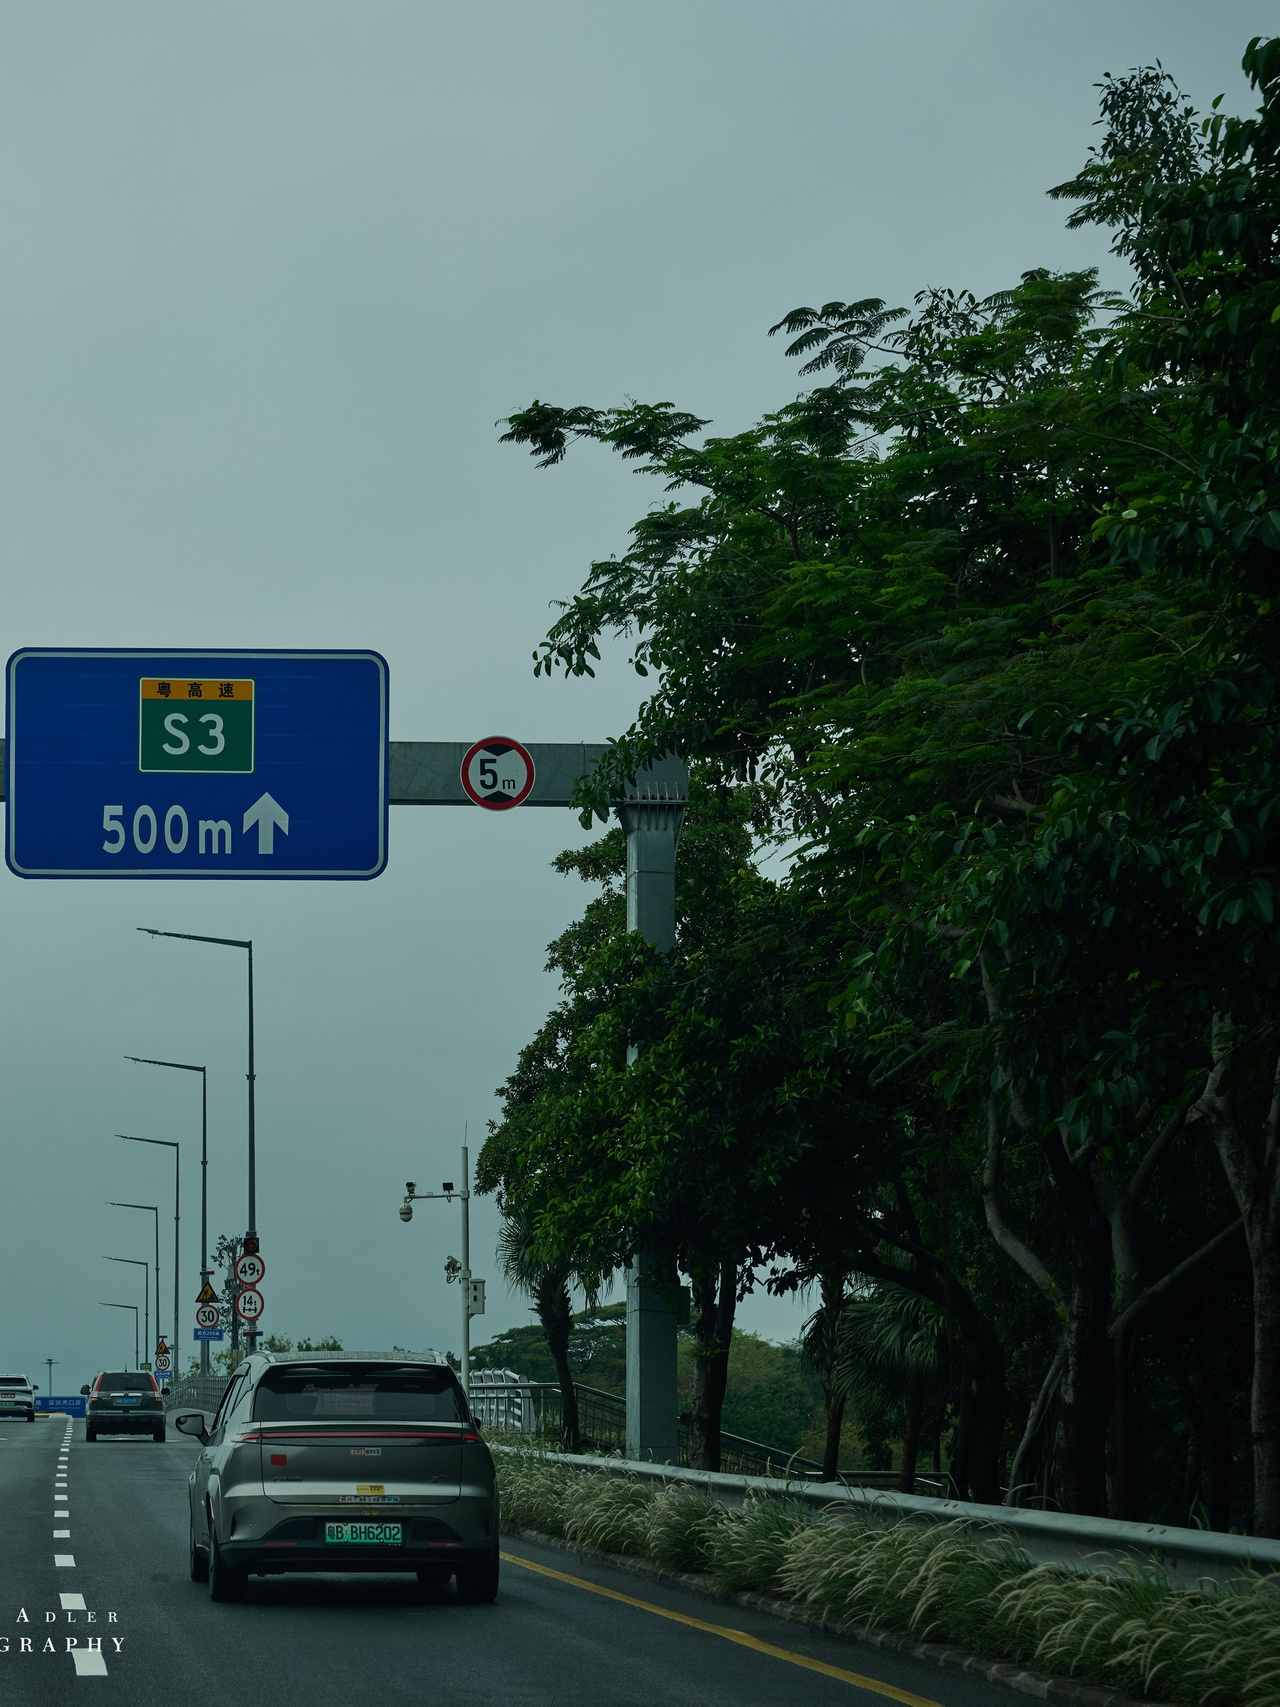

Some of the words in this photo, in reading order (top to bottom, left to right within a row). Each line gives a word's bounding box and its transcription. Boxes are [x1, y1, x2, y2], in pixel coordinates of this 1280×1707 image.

[156, 681, 235, 699] 粤高速
[161, 712, 226, 757] S3
[102, 804, 233, 855] 500m
[200, 1310, 215, 1323] 30
[158, 1358, 167, 1368] 30
